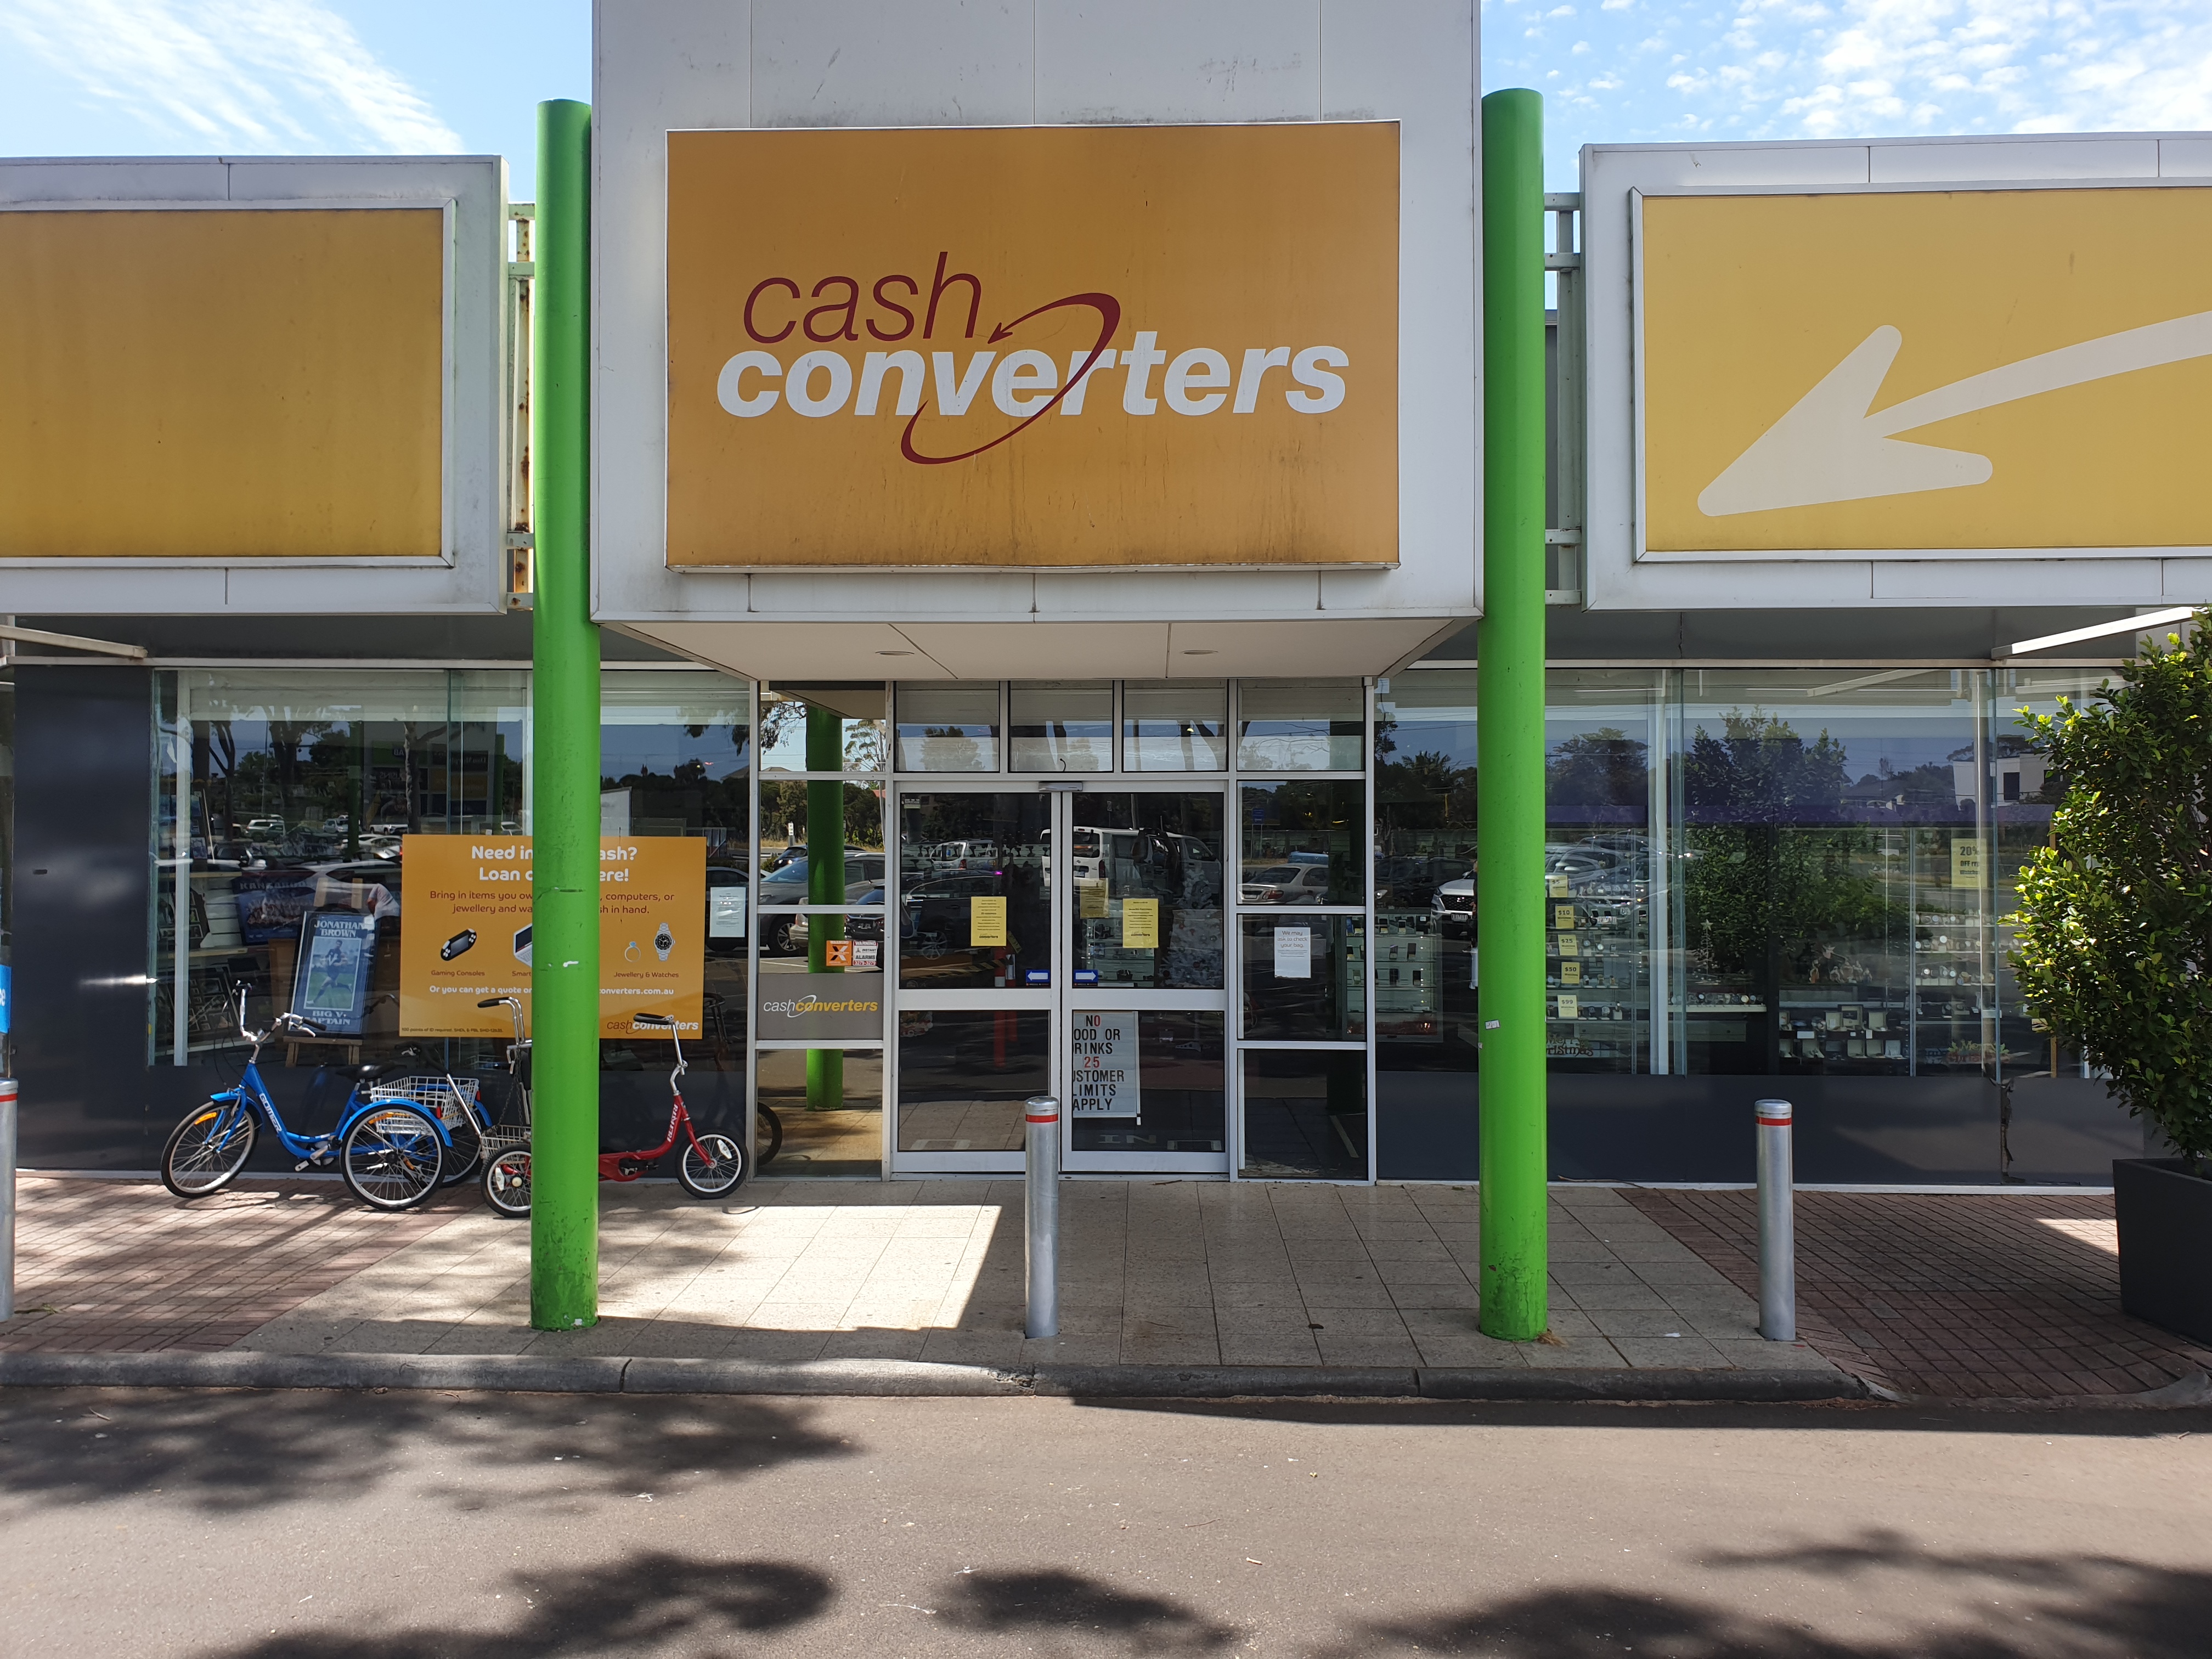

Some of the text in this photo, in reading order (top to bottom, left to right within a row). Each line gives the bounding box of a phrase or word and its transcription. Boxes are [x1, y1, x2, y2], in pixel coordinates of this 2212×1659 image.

[744, 252, 981, 342] cash
[716, 330, 1350, 417] converters
[472, 845, 637, 860] Need in ash?
[479, 867, 520, 881] Loan
[600, 868, 629, 882] ere!
[430, 891, 455, 900] Bring
[470, 891, 495, 899] items
[606, 893, 661, 902] computers,
[452, 904, 495, 914] jewellery
[498, 905, 516, 913] and
[622, 905, 650, 913] hand.
[320, 929, 356, 937] BROWN
[306, 1017, 350, 1025] APTAIN
[1086, 1015, 1101, 1027] NO
[1074, 1029, 1120, 1040] OOD OR
[1073, 1042, 1113, 1054] RINKS
[1084, 1057, 1100, 1068] 25
